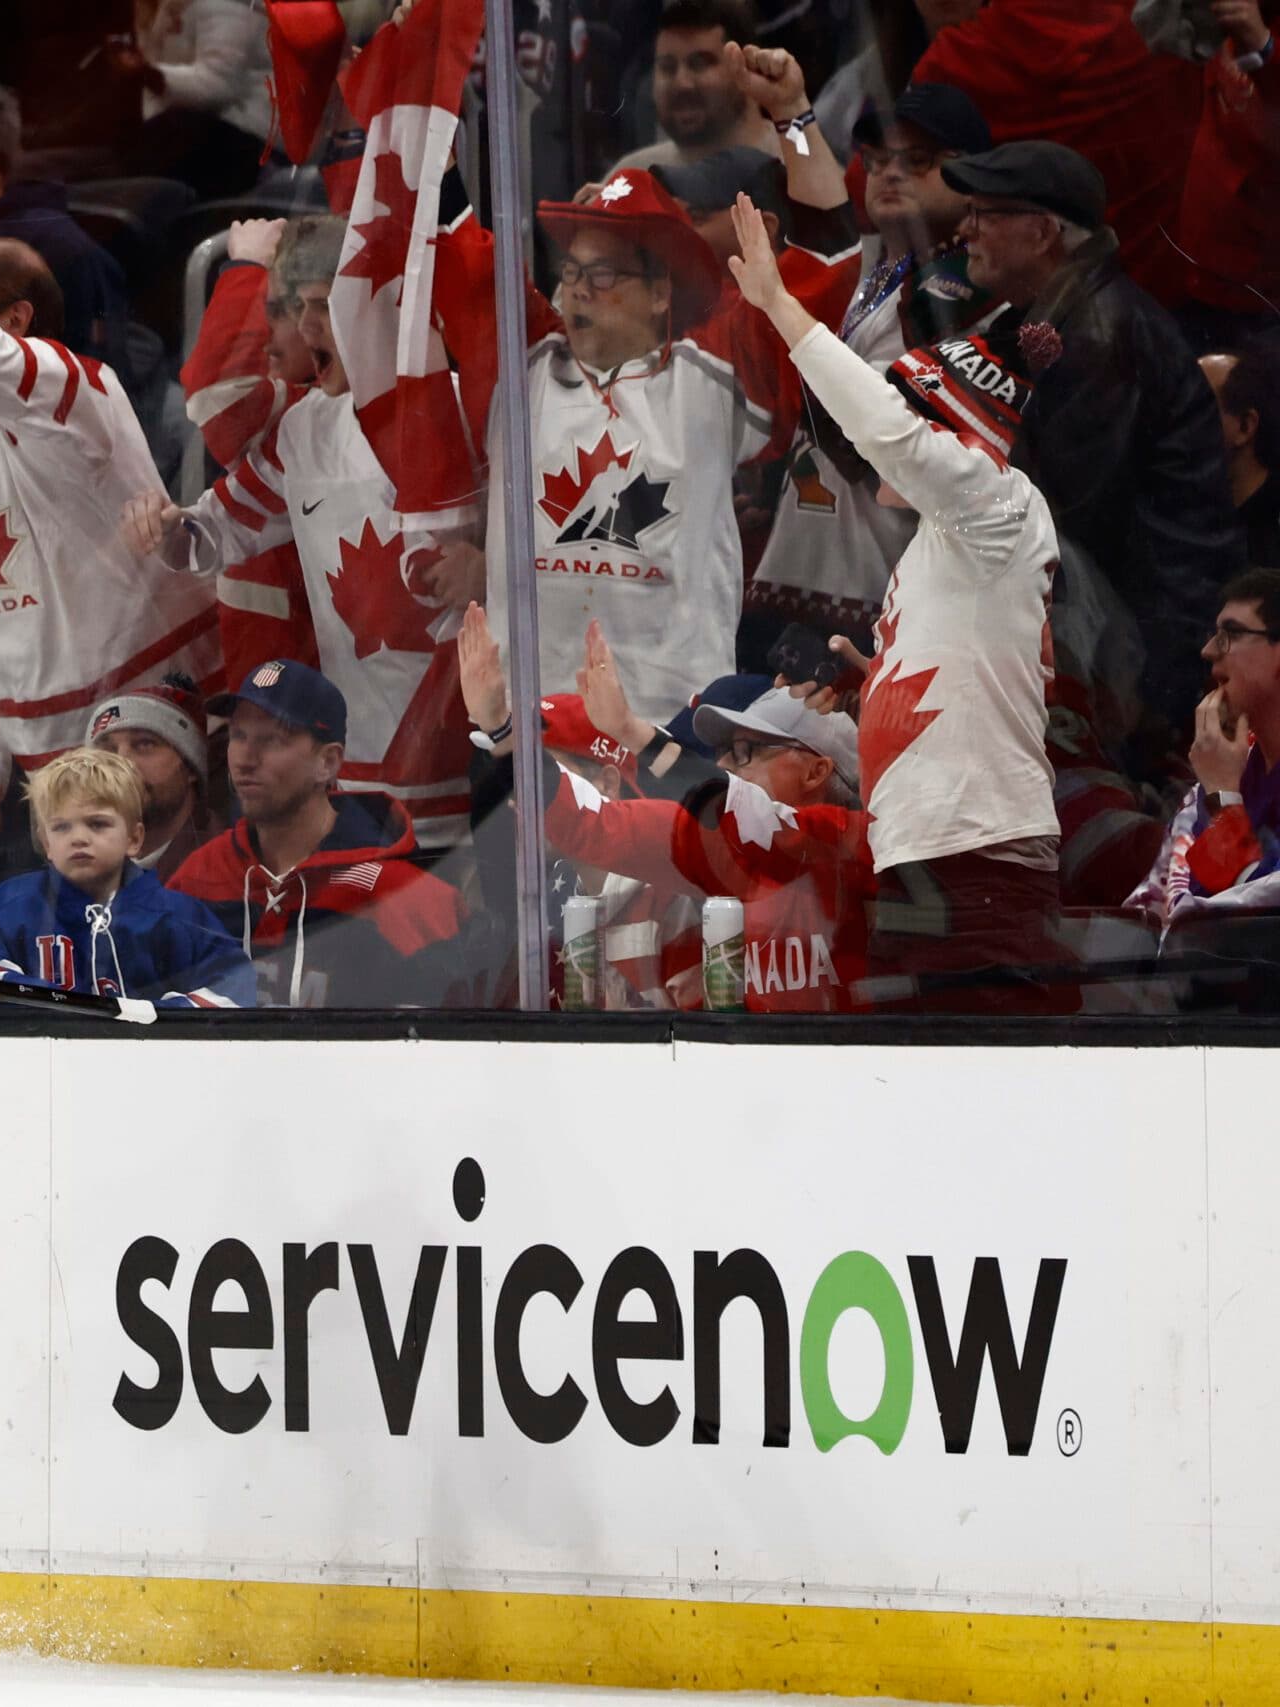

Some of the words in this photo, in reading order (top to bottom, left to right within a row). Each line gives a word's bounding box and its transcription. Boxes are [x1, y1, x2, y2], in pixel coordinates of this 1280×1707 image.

[534, 557, 665, 581] CANADA
[589, 735, 629, 767] 45-47
[744, 933, 840, 995] NADA
